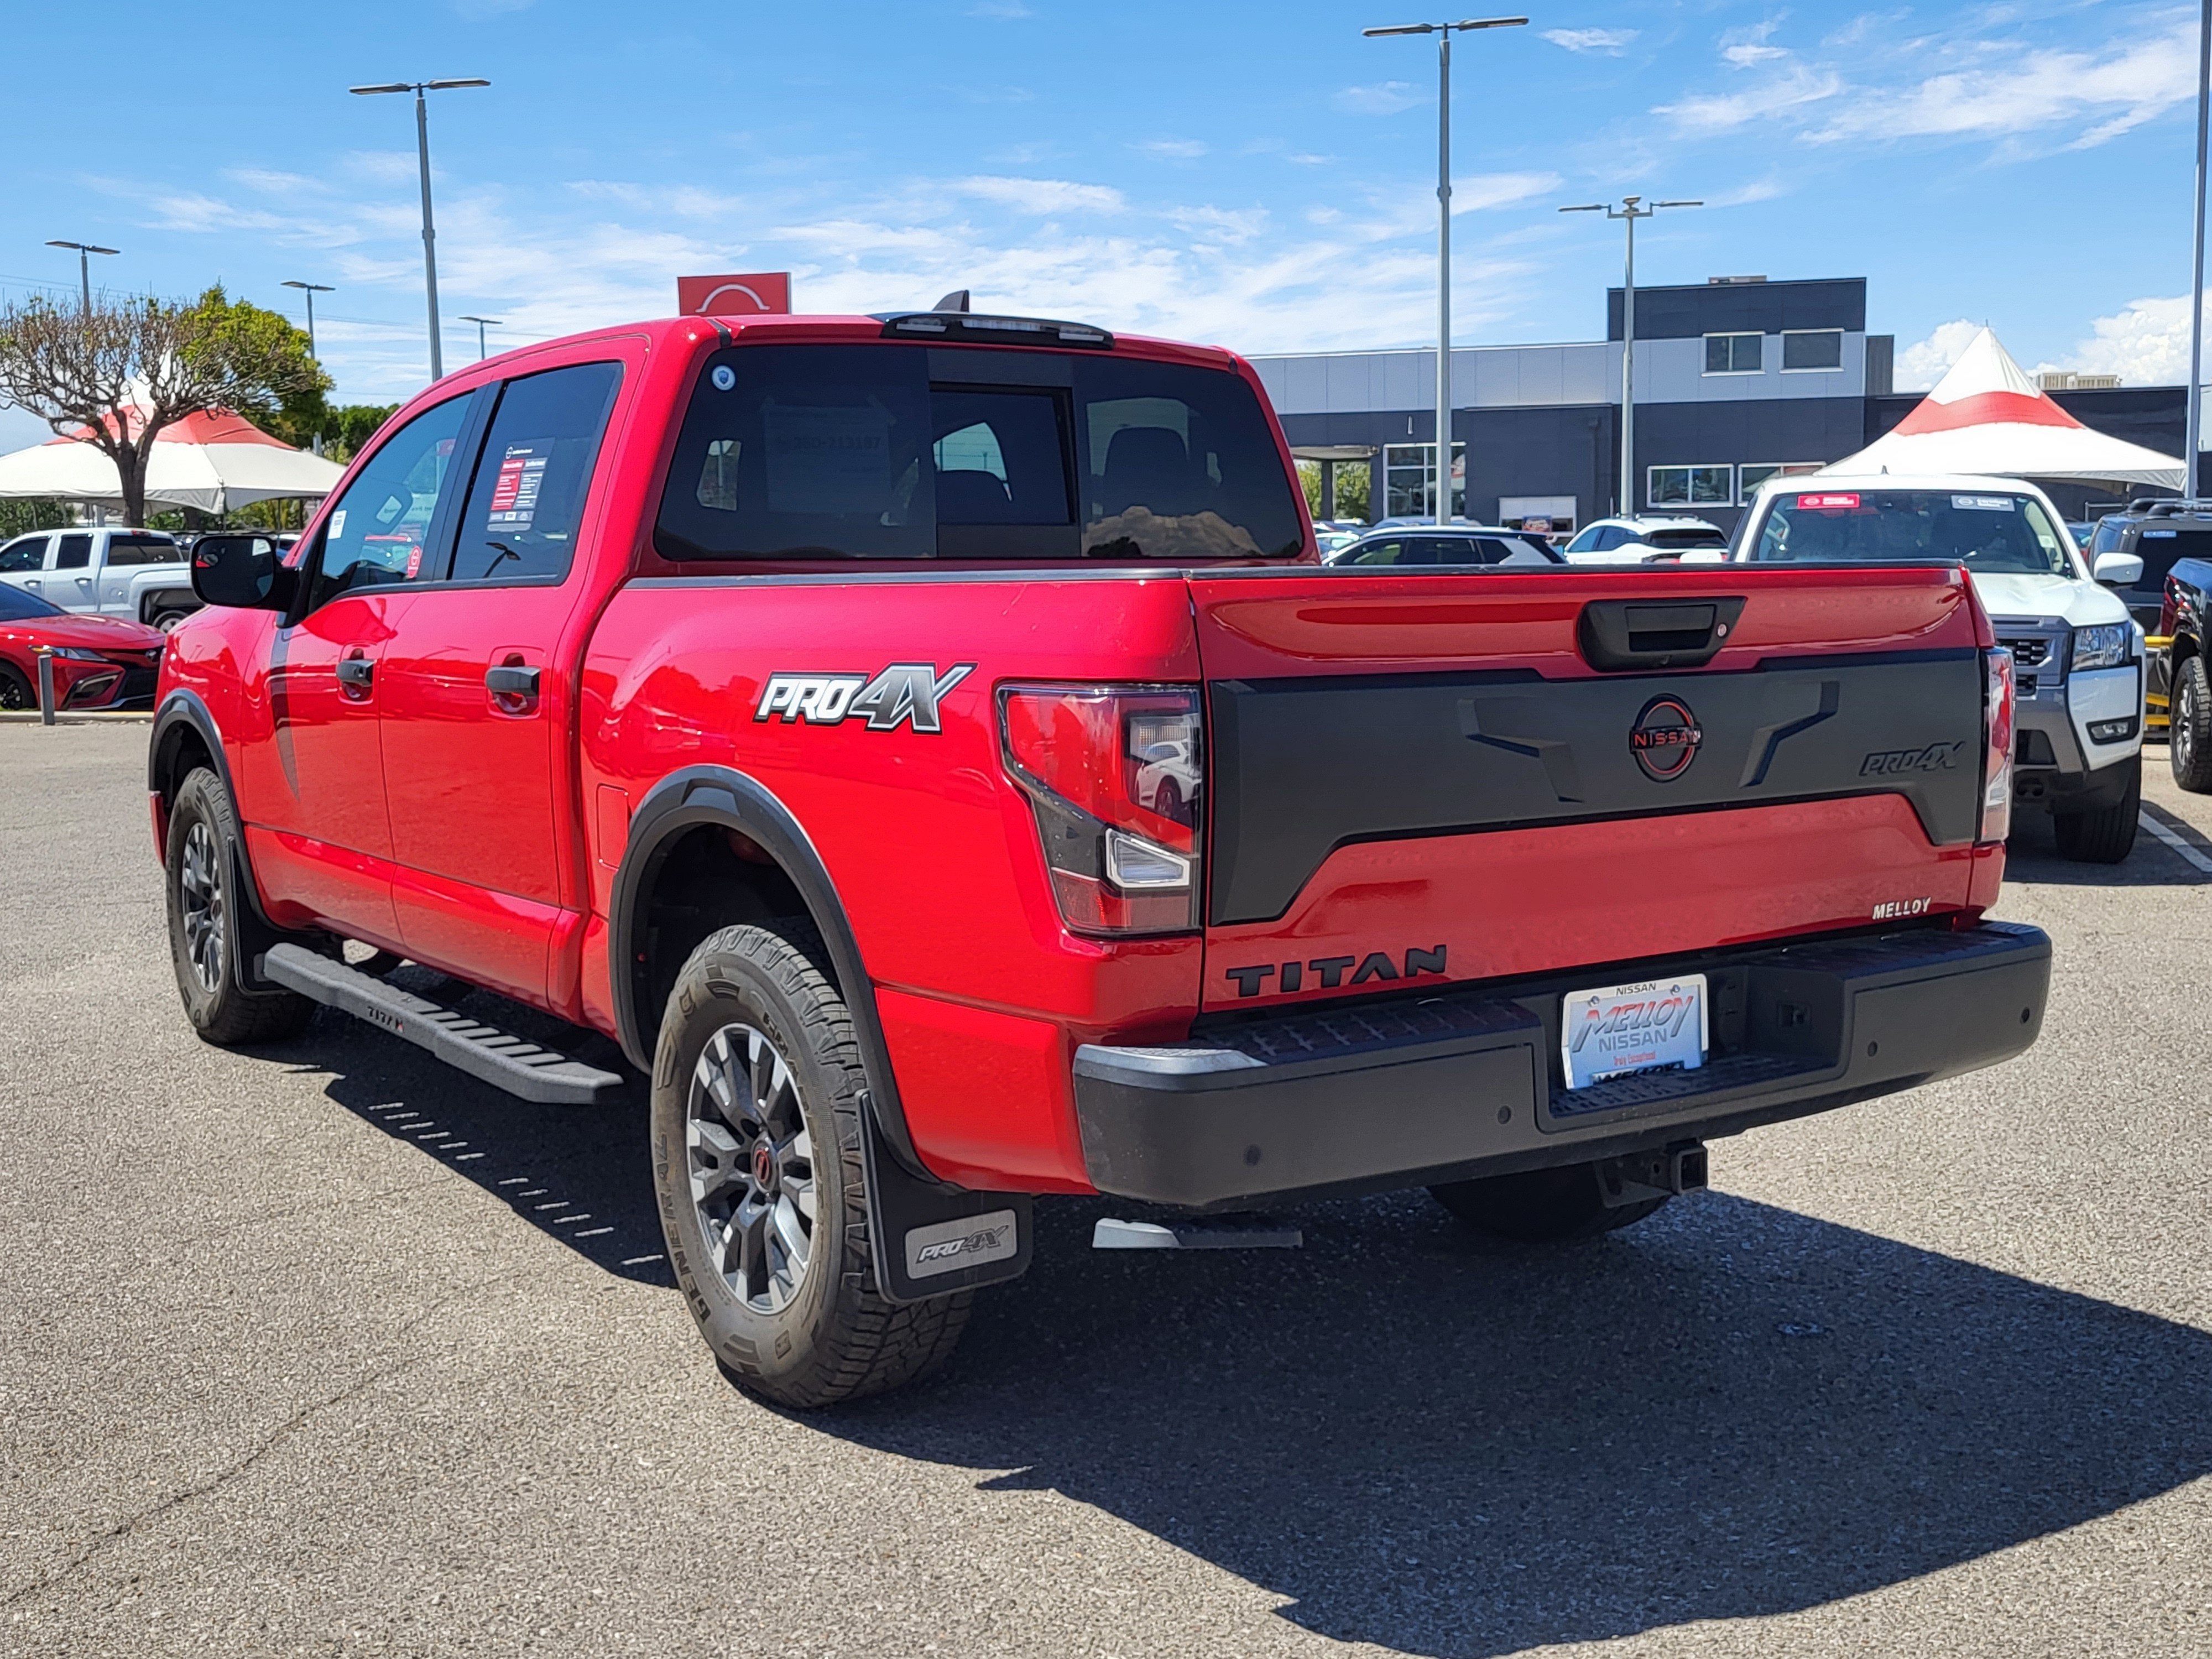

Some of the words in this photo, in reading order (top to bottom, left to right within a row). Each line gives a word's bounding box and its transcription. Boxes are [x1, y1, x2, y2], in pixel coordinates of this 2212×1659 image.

[753, 662, 978, 734] PRO4X
[1634, 731, 1701, 747] NISSAN
[1872, 896, 1931, 920] MELLOY
[1225, 944, 1447, 997] TITAN
[1616, 983, 1656, 996] NISSAN
[1599, 1028, 1667, 1052] NISSAN
[916, 1224, 1009, 1264] PRO4X
